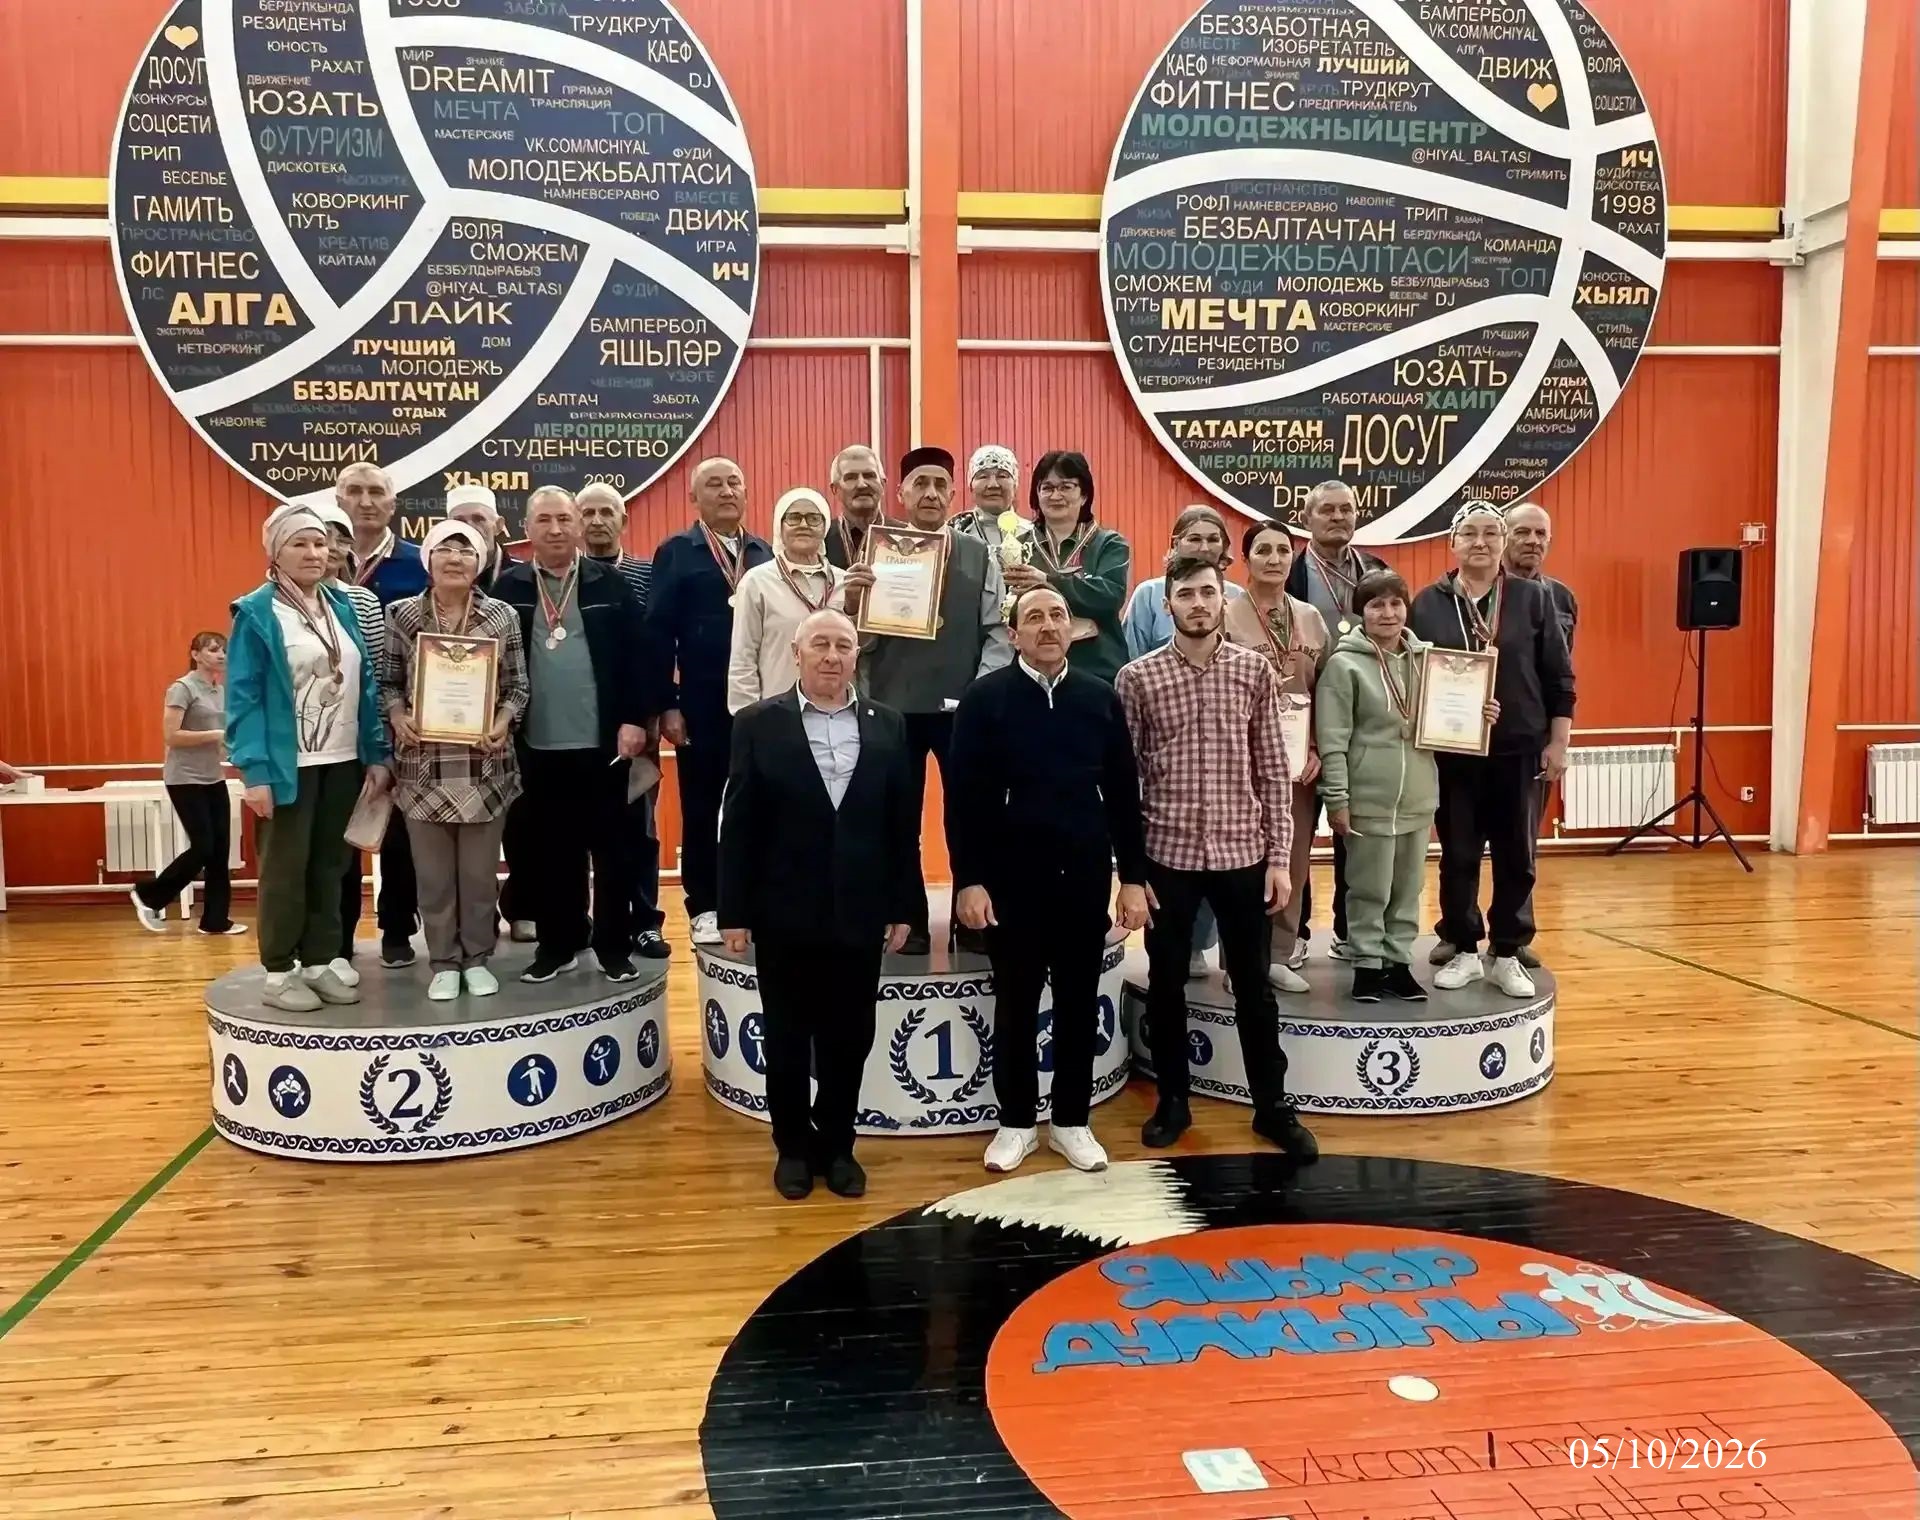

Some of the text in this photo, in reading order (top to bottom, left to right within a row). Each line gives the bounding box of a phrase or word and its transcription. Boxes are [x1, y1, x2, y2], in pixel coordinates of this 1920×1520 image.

[503, 1, 568, 17] ЗАБОТА
[1238, 5, 1356, 15] ВРЕМЯМОЛОДЫХ
[1420, 6, 1526, 23] БАМПЕРБОЛ
[242, 16, 347, 33] РЕЗИДЕНТЫ
[568, 15, 673, 36] ТРУДКРУТ
[1200, 15, 1370, 39] БЕЗЗАБОТНАЯ
[1579, 24, 1596, 36] ОН
[1429, 24, 1540, 42] VK.COM/MCHIYAL
[267, 40, 328, 54] ЮНОСТЬ
[648, 39, 692, 64] КАЕФ
[1180, 37, 1241, 50] ВМЕСТЕ
[1262, 38, 1395, 57] ИЗОБРЕТАТЕЛЬ
[1456, 44, 1485, 56] АЛГА
[1583, 38, 1607, 49] ОНА
[402, 49, 434, 62] МИР
[465, 56, 505, 67] ЗНАНИЕ
[1211, 55, 1311, 68] НЕФОРМАЛЬНАЯ
[148, 56, 207, 88] ДОСУГ
[310, 58, 364, 74] РАХАТ
[1166, 53, 1208, 77] КАЕФ
[1317, 55, 1410, 76] ЛУЧШИЙ
[1477, 56, 1553, 82] ДВИЖ
[1587, 57, 1621, 74] ВОЛЯ
[247, 74, 312, 87] ДВИЖЕНИЕ
[409, 65, 555, 95] DREAMIT
[689, 73, 711, 90] DJ
[562, 85, 613, 96] ПРЯМАЯ
[1150, 79, 1296, 112] ФИТНЕС
[1340, 80, 1433, 99] ТРУДКРУТ
[131, 93, 208, 107] КОНКУРСЫ
[250, 89, 379, 118] ЮЗАТЬ
[530, 97, 612, 110] ТРАНСЛЯЦИЯ
[1299, 98, 1418, 112] ПРЕДПРИНИМАТЕЛЬ
[1594, 95, 1637, 112] СОЦСЕТИ
[433, 99, 520, 122] МЕЧТА
[128, 113, 212, 137] СОЦСЕТИ
[606, 111, 665, 136] ТОП
[1141, 113, 1488, 147] МОЛОДЕЖНЫЙЦЕНТР
[260, 124, 383, 158] ФУТУРИЗМ
[434, 128, 515, 141] МАСТЕРСКИЕ
[128, 144, 181, 161] ТРИП
[524, 137, 650, 156] VK.COM/MCHIYAL
[672, 147, 712, 162] ФУДИ
[1123, 150, 1160, 161] КАЙТАМ
[1412, 147, 1531, 166] @HIYAL_BALTASI
[1621, 149, 1654, 168] ИЧ
[267, 161, 348, 175] ДИСКОТЕКА
[468, 158, 732, 186] МОЛОДЕЖЬБАЛТАСИ
[1506, 168, 1568, 181] СТРИМИТЬ
[1596, 168, 1630, 180] ФУДИ
[162, 171, 228, 186] ВЕСЕЛЬЕ
[543, 188, 660, 201] НАМНЕВСЕРАВНО
[1224, 182, 1339, 196] ПРОСТРАНСТВО
[1594, 181, 1661, 193] ДИСКОТЕКА
[292, 192, 410, 210] КОВОРКИНГ
[675, 191, 740, 206] ВМЕСТЕ
[1176, 194, 1231, 212] РОФЛ
[1233, 200, 1338, 213] НАМНЕВСЕРАВНО
[1346, 196, 1396, 207] НАВОЛНЕ
[1599, 194, 1657, 215] 1998
[133, 195, 234, 222] ГАМИТЬ
[620, 211, 661, 222] ПОБЕДА
[1406, 206, 1448, 222] ТРИП
[287, 213, 340, 230] ПУТЬ
[664, 207, 749, 236] ДВИЖ
[1183, 216, 1396, 242] БЕЗБАЛТАЧТАН
[1618, 221, 1661, 235] РАХАТ
[121, 226, 255, 243] ПРОСТРАНСТВО
[451, 222, 504, 240] ВОЛЯ
[1120, 227, 1177, 239] ДВИЖЕНИЕ
[1403, 229, 1482, 242] БЕРДУЛКЫНДА
[318, 236, 390, 250] КРЕАТИВ
[696, 240, 737, 253] ИГРА
[1484, 238, 1557, 256] КОМАНДА
[318, 253, 377, 267] КАЙТАМ
[470, 242, 578, 262] СМОЖЕМ
[1113, 241, 1468, 277] МОЛОДЕЖЬБАЛТАСИ
[131, 251, 260, 280] ФИТНЕС
[1471, 256, 1512, 265] ЭКСТРИМ
[427, 264, 542, 277] БЕЗБУЛДЫРАБЫЗ
[712, 262, 750, 281] ИЧ
[1496, 266, 1548, 289] ТОП
[1582, 271, 1632, 283] ЮНОСТЬ
[426, 281, 563, 298] @HIYAL_BALTASI
[612, 283, 659, 298] ФУДИ
[1114, 275, 1212, 293] СМОЖЕМ
[1220, 279, 1264, 296] ФУДИ
[1277, 276, 1384, 295] МОЛОДЕЖЬ
[1390, 276, 1490, 289] БЕЗБУЛДЫРАБЫЗ
[1389, 291, 1429, 301] ВЕСЕЛЬЕ
[1435, 291, 1456, 308] DJ
[1576, 286, 1650, 306] ХЫЯЛ
[168, 291, 297, 327] АЛГА
[389, 296, 513, 325] ЛАЙК
[1115, 296, 1160, 313] ПУТЬ
[1319, 302, 1420, 318] КОВОРКИНГ
[1160, 297, 1317, 332] МЕЧТА
[156, 327, 206, 337] ЭКСТРИМ
[590, 318, 707, 334] БАМПЕРБОЛ
[1323, 322, 1393, 333] МАСТЕРСКИЕ
[1596, 323, 1634, 335] СТИЛЬ
[481, 336, 512, 349] ДОМ
[1481, 328, 1530, 341] ЛУЧШИЙ
[1605, 336, 1640, 349] ИНДЕ
[177, 343, 265, 355] НЕТВОРКИНГ
[353, 337, 456, 356] ЛУЧШИЙ
[600, 338, 722, 367] ЯШЬЛӘР
[1129, 334, 1300, 356] СТУДЕНЧЕСТВО
[1438, 344, 1492, 357] БАЛТАЧ
[381, 359, 503, 378] МОЛОДЕЖЬ
[1197, 357, 1285, 372] РЕЗИДЕНТЫ
[1552, 357, 1579, 370] ДОМ
[1138, 375, 1215, 387] НЕТВОРКИНГ
[1393, 359, 1508, 388] ЮЗАТЬ
[293, 380, 480, 402] БЕЗБАЛТАЧТАН
[652, 393, 701, 405] ЗАБОТА
[1322, 391, 1424, 407] РАБОТАЮЩАЯ
[1423, 387, 1496, 410] ХАЙП
[1539, 389, 1593, 405] HIYAL
[537, 393, 599, 407] БАЛТАЧ
[209, 416, 267, 428] НАВОЛНЕ
[570, 411, 694, 421] ВРЕМЯМОЛОДЫХ
[1525, 408, 1593, 423] АМБИЦИИ
[303, 422, 422, 437] РАБОТАЮЩАЯ
[534, 423, 684, 440] МЕРОПРИЯТИЯ
[1171, 420, 1323, 439] ТАТАРСТАН
[1516, 423, 1576, 435] КОНКУРСЫ
[249, 438, 379, 463] ЛУЧШИЙ
[482, 440, 669, 461] СТУДЕНЧЕСТВО
[1182, 439, 1233, 450] СТУДСИЛА
[1253, 438, 1335, 453] ИСТОРИЯ
[1338, 413, 1459, 477] ДОСУГ
[1199, 454, 1334, 470] МЕРОПРИЯТИЯ
[1504, 458, 1548, 468] ПРЯМАЯ
[266, 466, 338, 482] ФОРУМ
[443, 470, 529, 490] ХЫЯЛ
[584, 473, 625, 488] 2020
[1221, 470, 1283, 486] ФОРУМ
[1368, 468, 1426, 486] ТАНЦЫ
[1477, 470, 1546, 480] ТРАНСЛЯЦИЯ
[1273, 485, 1398, 508] DRMIT
[1460, 485, 1519, 500] ЯШЬЛӘР
[924, 1020, 964, 1080] 1
[1376, 1050, 1401, 1086] 3
[387, 1068, 424, 1119] 2
